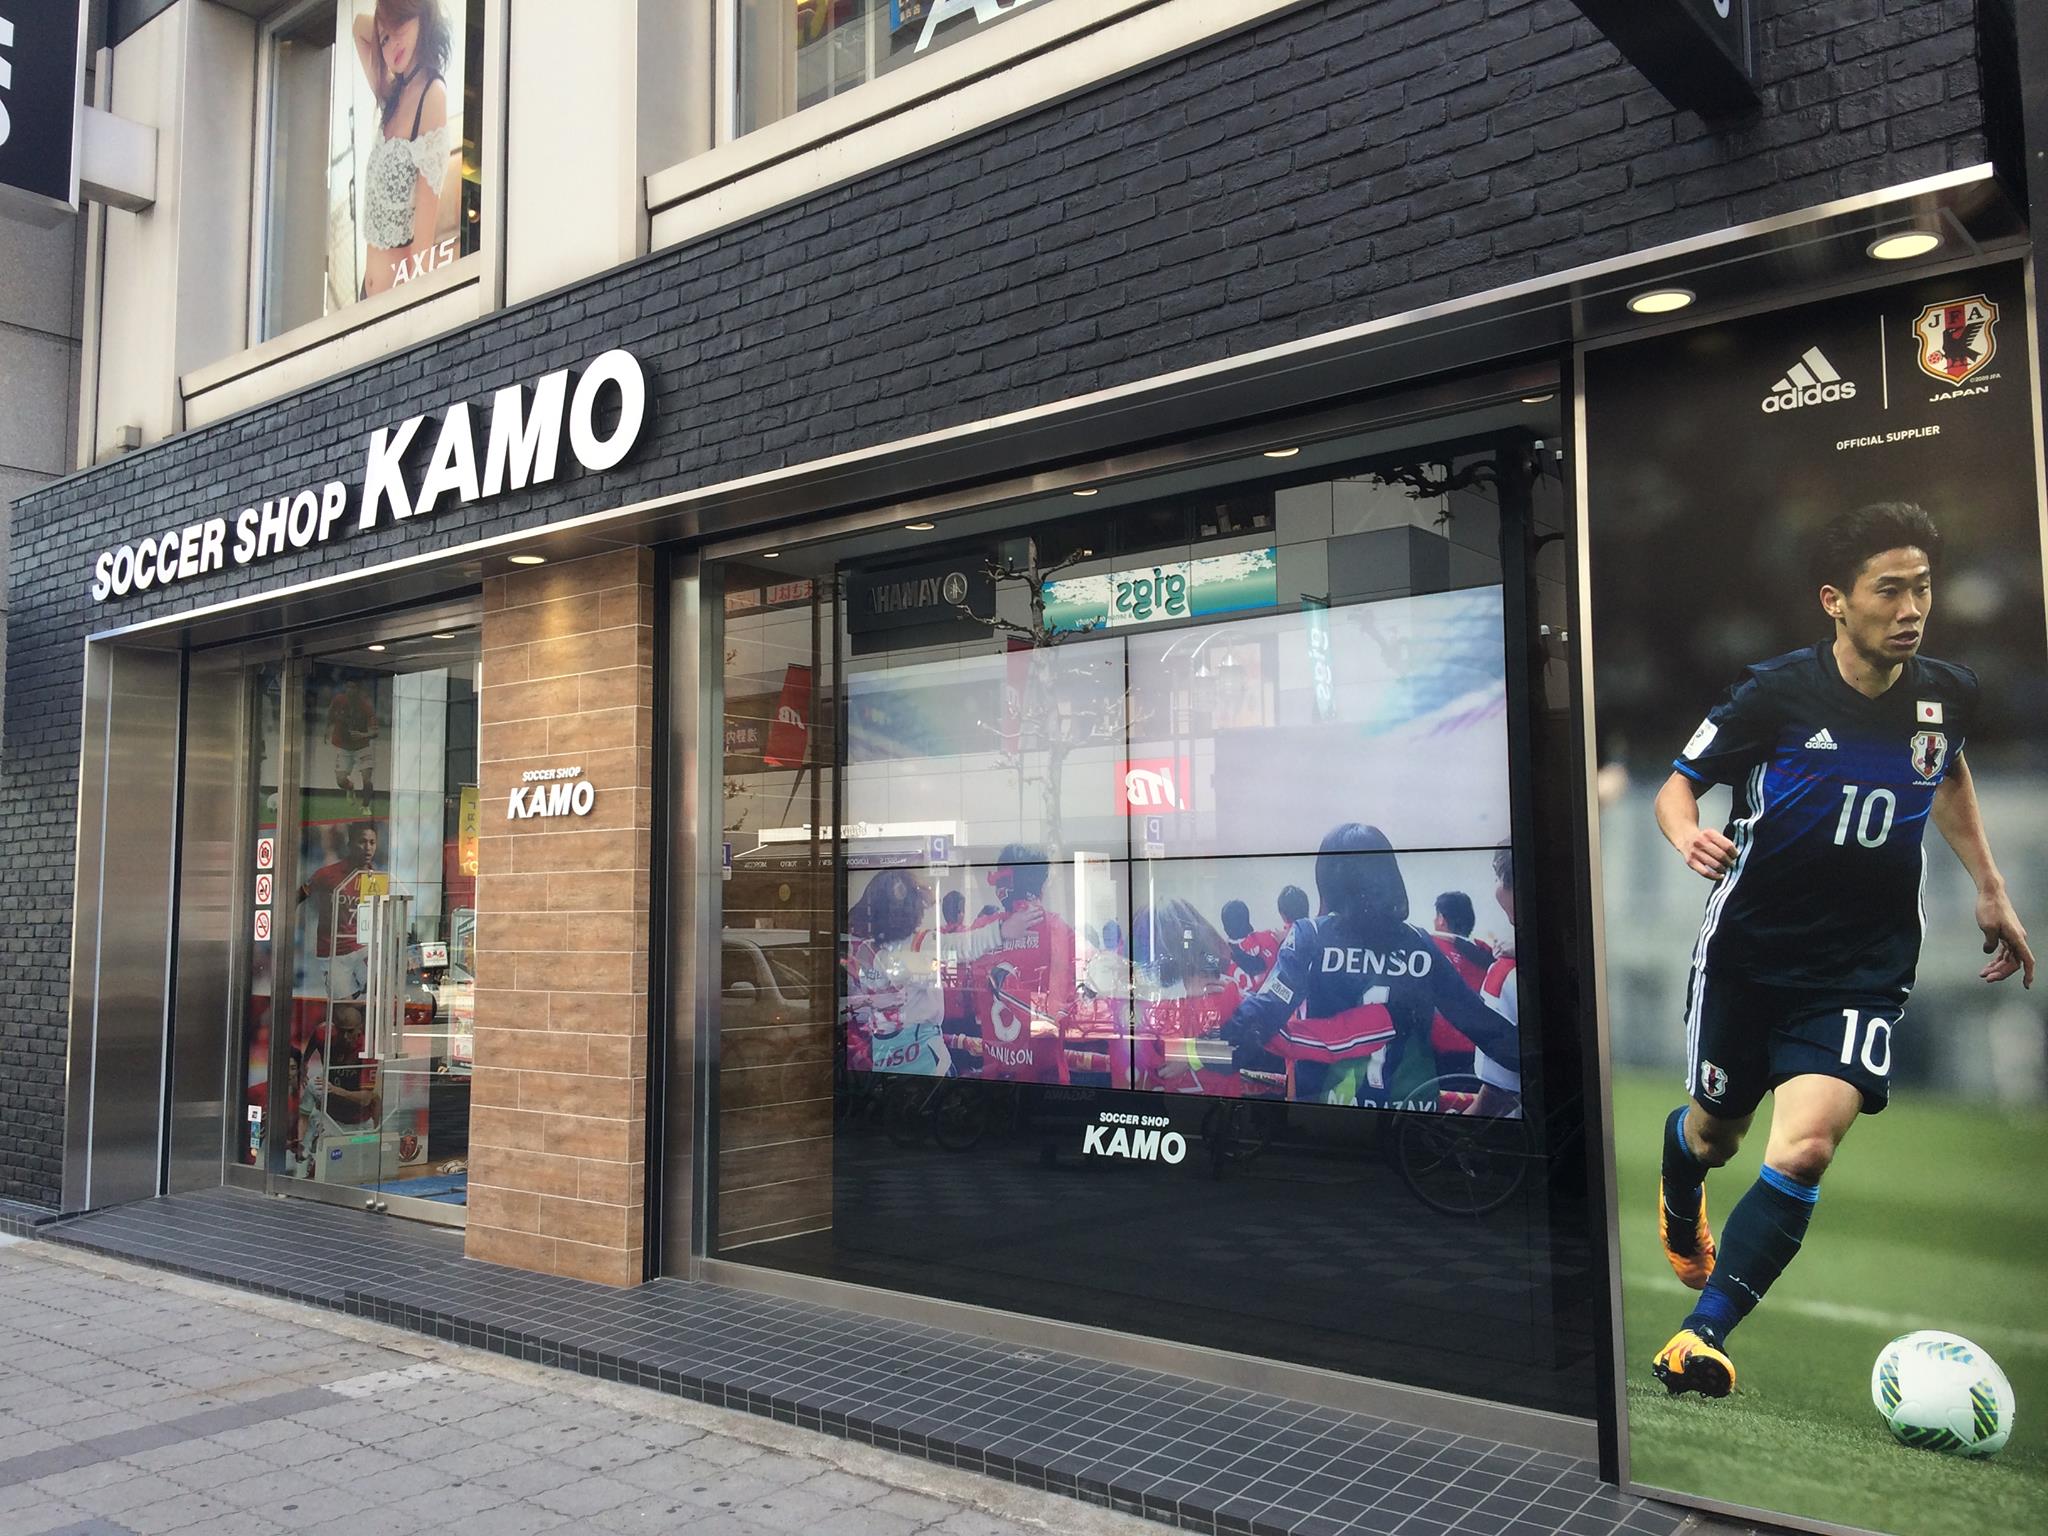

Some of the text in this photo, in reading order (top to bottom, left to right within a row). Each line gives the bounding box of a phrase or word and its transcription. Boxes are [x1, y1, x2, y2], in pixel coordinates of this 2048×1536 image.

[1761, 380, 1857, 414] adidas
[1928, 385, 1989, 402] JAPAN
[1836, 425, 1941, 451] OFFICIAL SUPPLIER
[91, 348, 646, 602] SOCCER SHOP KAMO
[1805, 740, 1838, 750] adidas
[522, 766, 582, 782] SOCCER SHOP
[507, 780, 595, 820] KAMO
[1833, 785, 1897, 849] 10
[1321, 947, 1433, 978] DENSO
[1840, 1008, 1891, 1076] 10
[1100, 1112, 1170, 1127] SOCCER SHOP
[1082, 1124, 1187, 1164] KAMO
